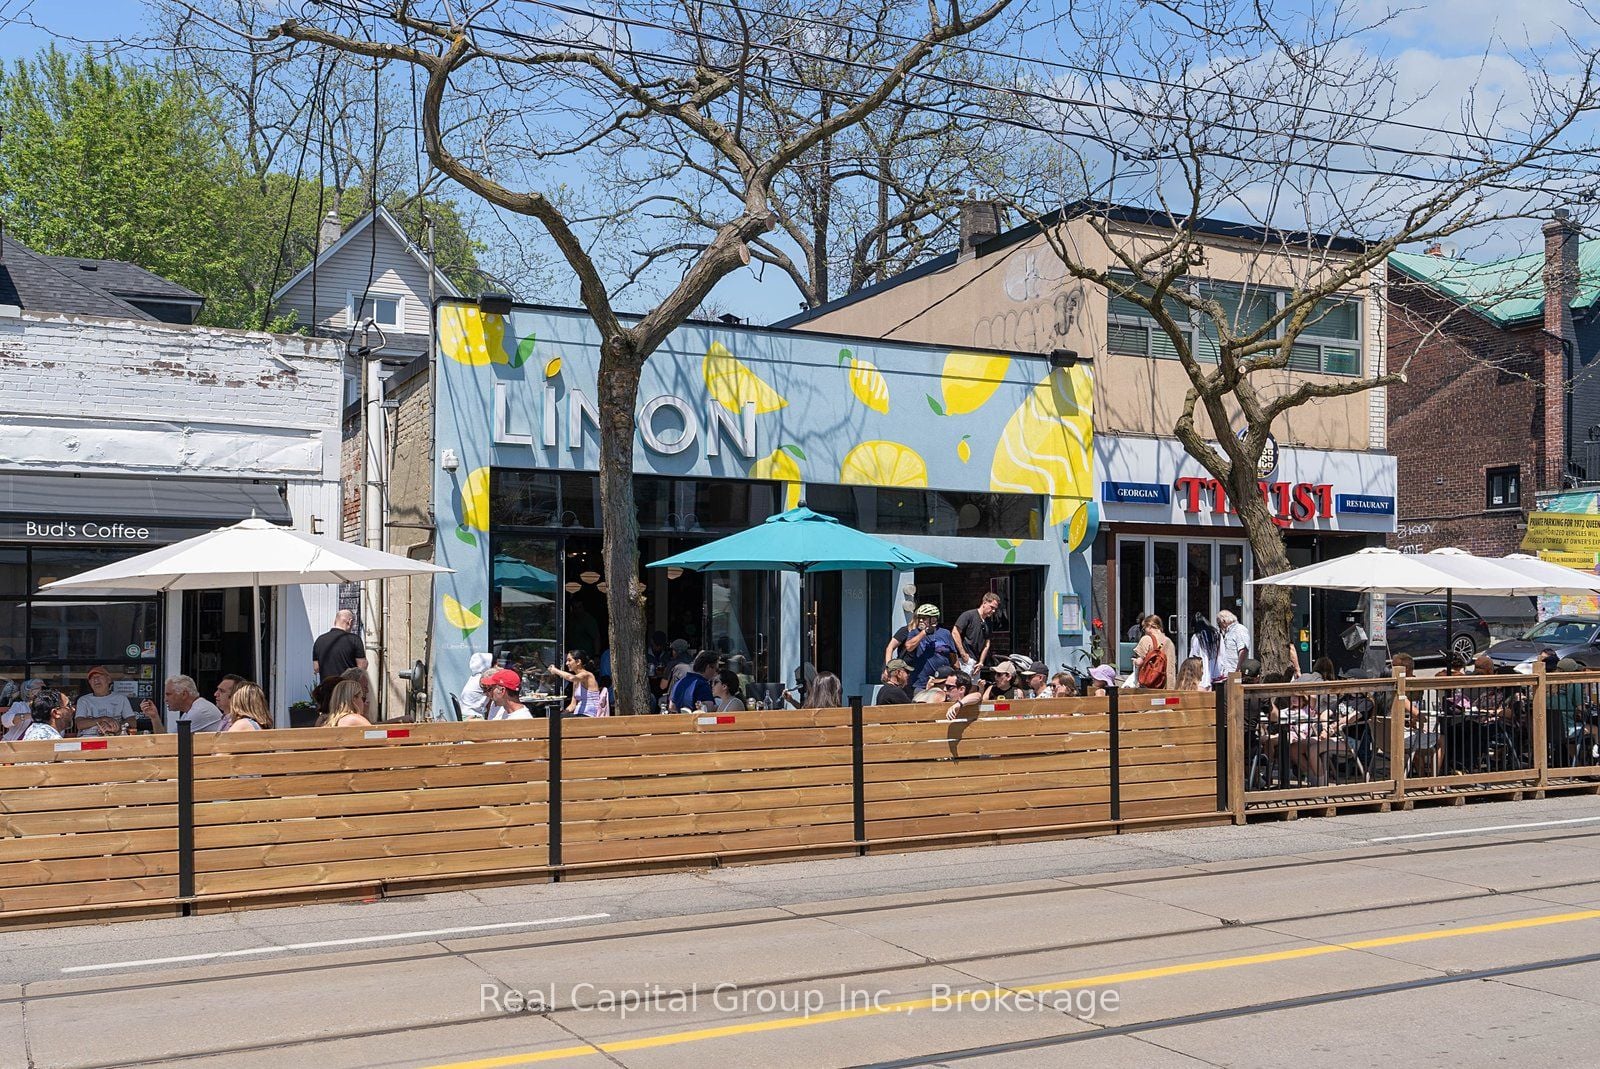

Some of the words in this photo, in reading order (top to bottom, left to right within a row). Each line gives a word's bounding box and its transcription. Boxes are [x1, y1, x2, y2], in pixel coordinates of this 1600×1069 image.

[1117, 488, 1159, 498] GEORGIAN
[1174, 476, 1334, 528] TIISI
[1346, 500, 1390, 510] RESTAURANT
[1530, 518, 1544, 527] PRIVATE
[1544, 518, 1564, 527] PARKING
[1564, 519, 1573, 527] FOR
[26, 521, 76, 537] Bud's
[82, 522, 149, 539] Coffee
